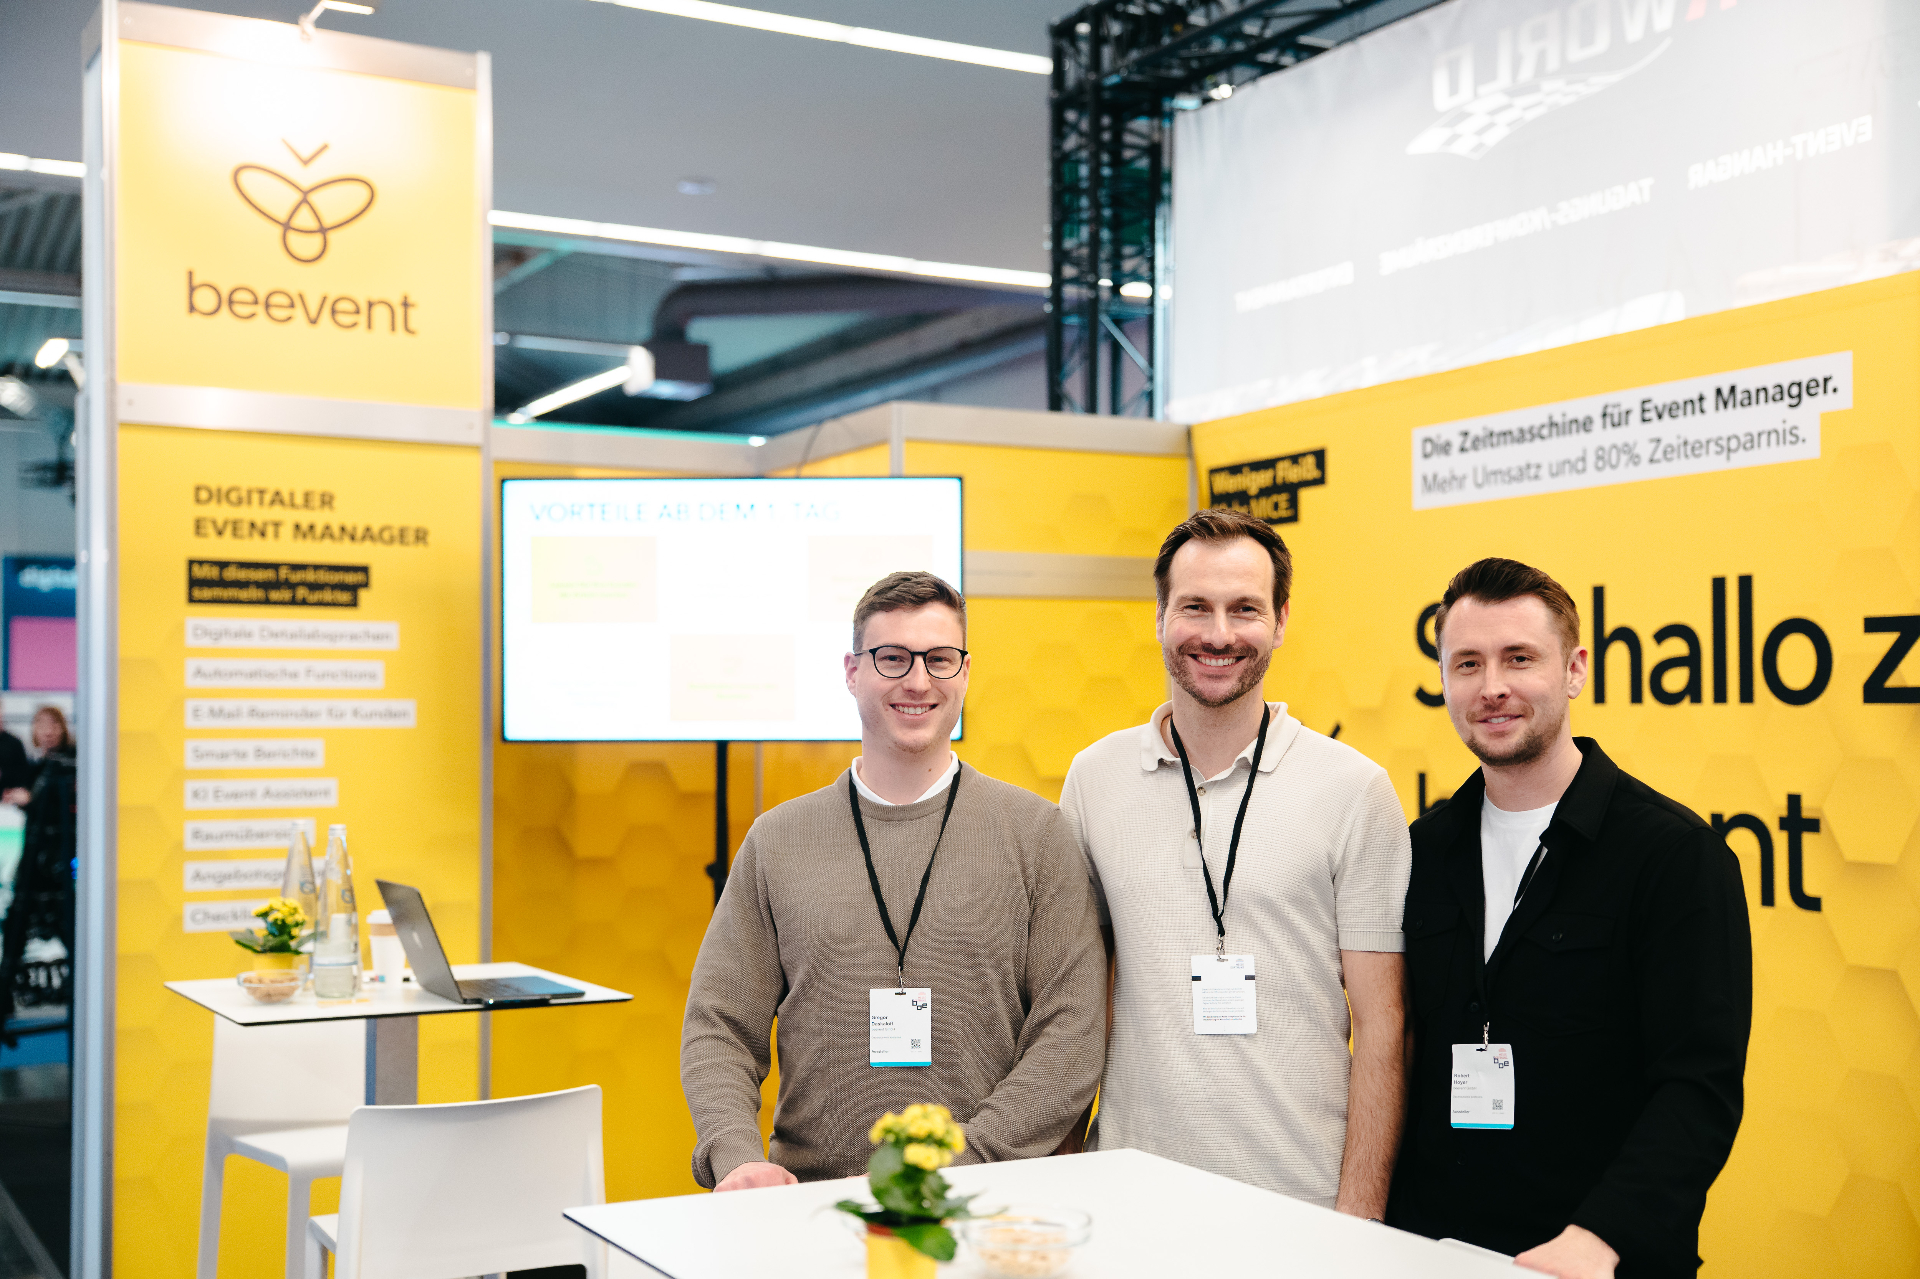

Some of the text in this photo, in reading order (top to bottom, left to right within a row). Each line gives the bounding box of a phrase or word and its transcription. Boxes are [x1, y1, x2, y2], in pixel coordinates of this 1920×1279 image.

[187, 270, 417, 334] beevent
[1421, 374, 1838, 459] Die Zeitmaschine für Event Manager.
[1421, 419, 1806, 495] Mehr Umsatz und 80% Zeitersparnis.
[194, 484, 336, 512] DIGITALER
[529, 501, 650, 522] VORTEILE
[658, 501, 691, 521] AB
[699, 501, 756, 521] DEM
[791, 500, 841, 521] TAG
[194, 517, 430, 547] EVENT MANAGER
[1592, 574, 1834, 706] hallo
